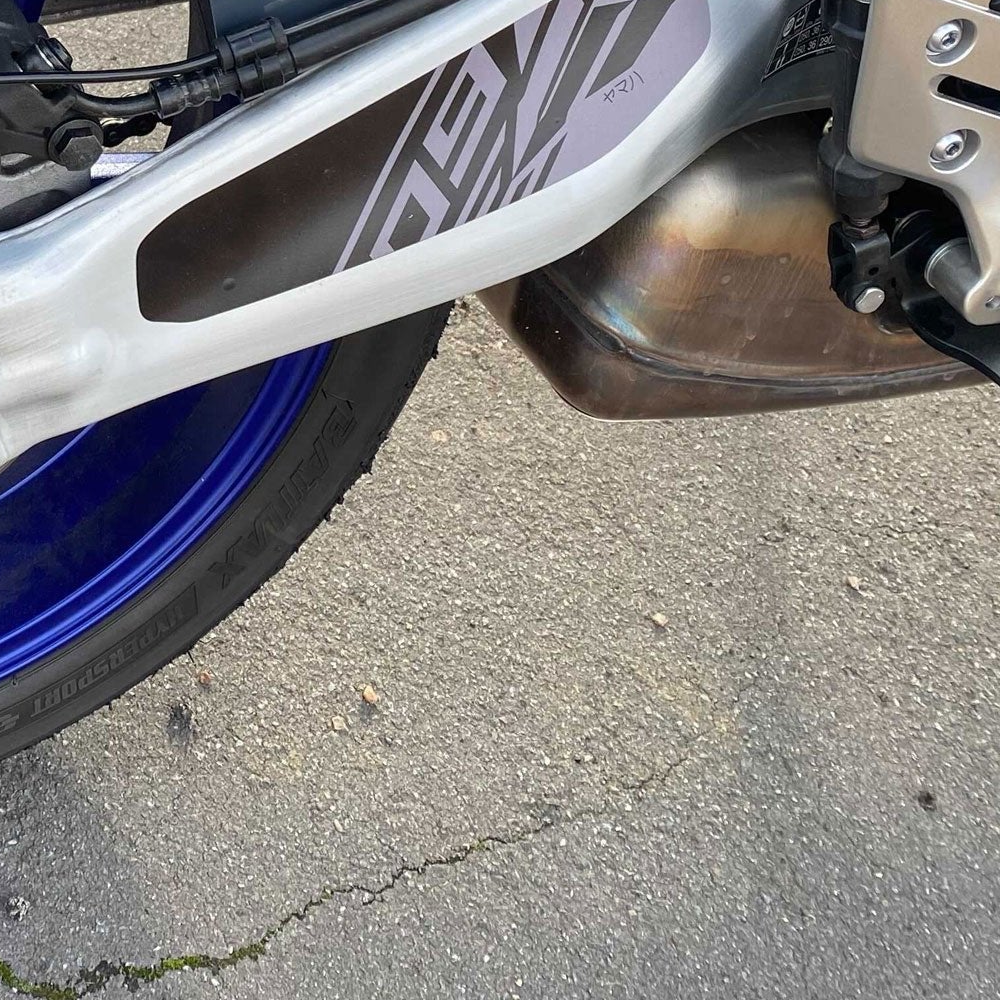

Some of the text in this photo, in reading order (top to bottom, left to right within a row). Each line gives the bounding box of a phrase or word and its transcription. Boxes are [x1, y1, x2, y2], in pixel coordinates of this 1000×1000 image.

[603, 70, 645, 104] ヤマハ
[30, 604, 184, 718] HYPERSPORT
